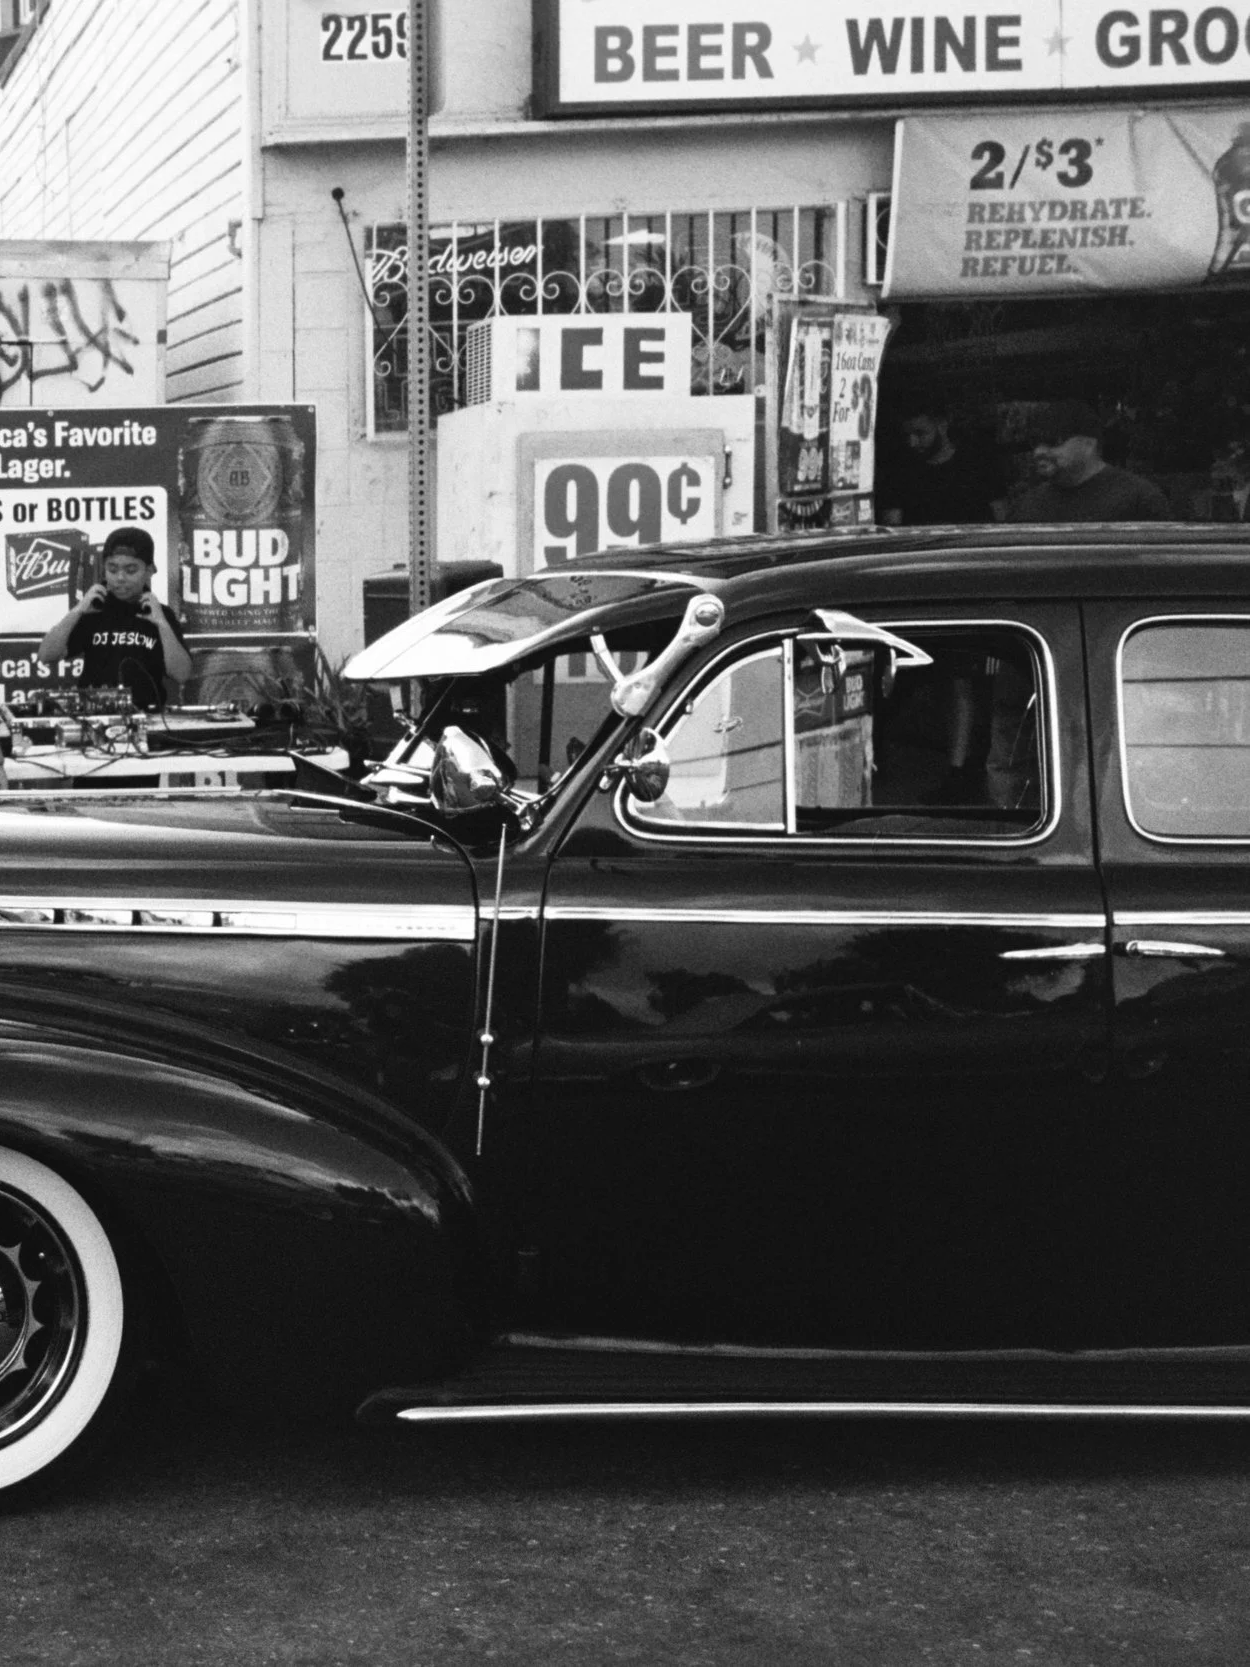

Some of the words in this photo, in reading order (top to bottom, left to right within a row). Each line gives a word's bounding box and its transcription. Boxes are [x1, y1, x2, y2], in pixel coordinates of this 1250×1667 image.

[593, 20, 775, 84] BEER
[845, 14, 1023, 76] WINE
[966, 196, 1152, 224] REHYDRATE.
[963, 225, 1135, 252] REPLENISH.
[364, 243, 544, 284] Bdweiser
[959, 254, 1080, 278] REFUEL.
[515, 327, 666, 392] ICE
[54, 420, 158, 447] Favorite
[12, 501, 40, 524] or
[47, 495, 156, 523] BOTTLES
[192, 528, 290, 567] BUD
[181, 564, 302, 607] LIGHT
[92, 631, 109, 645] DJ
